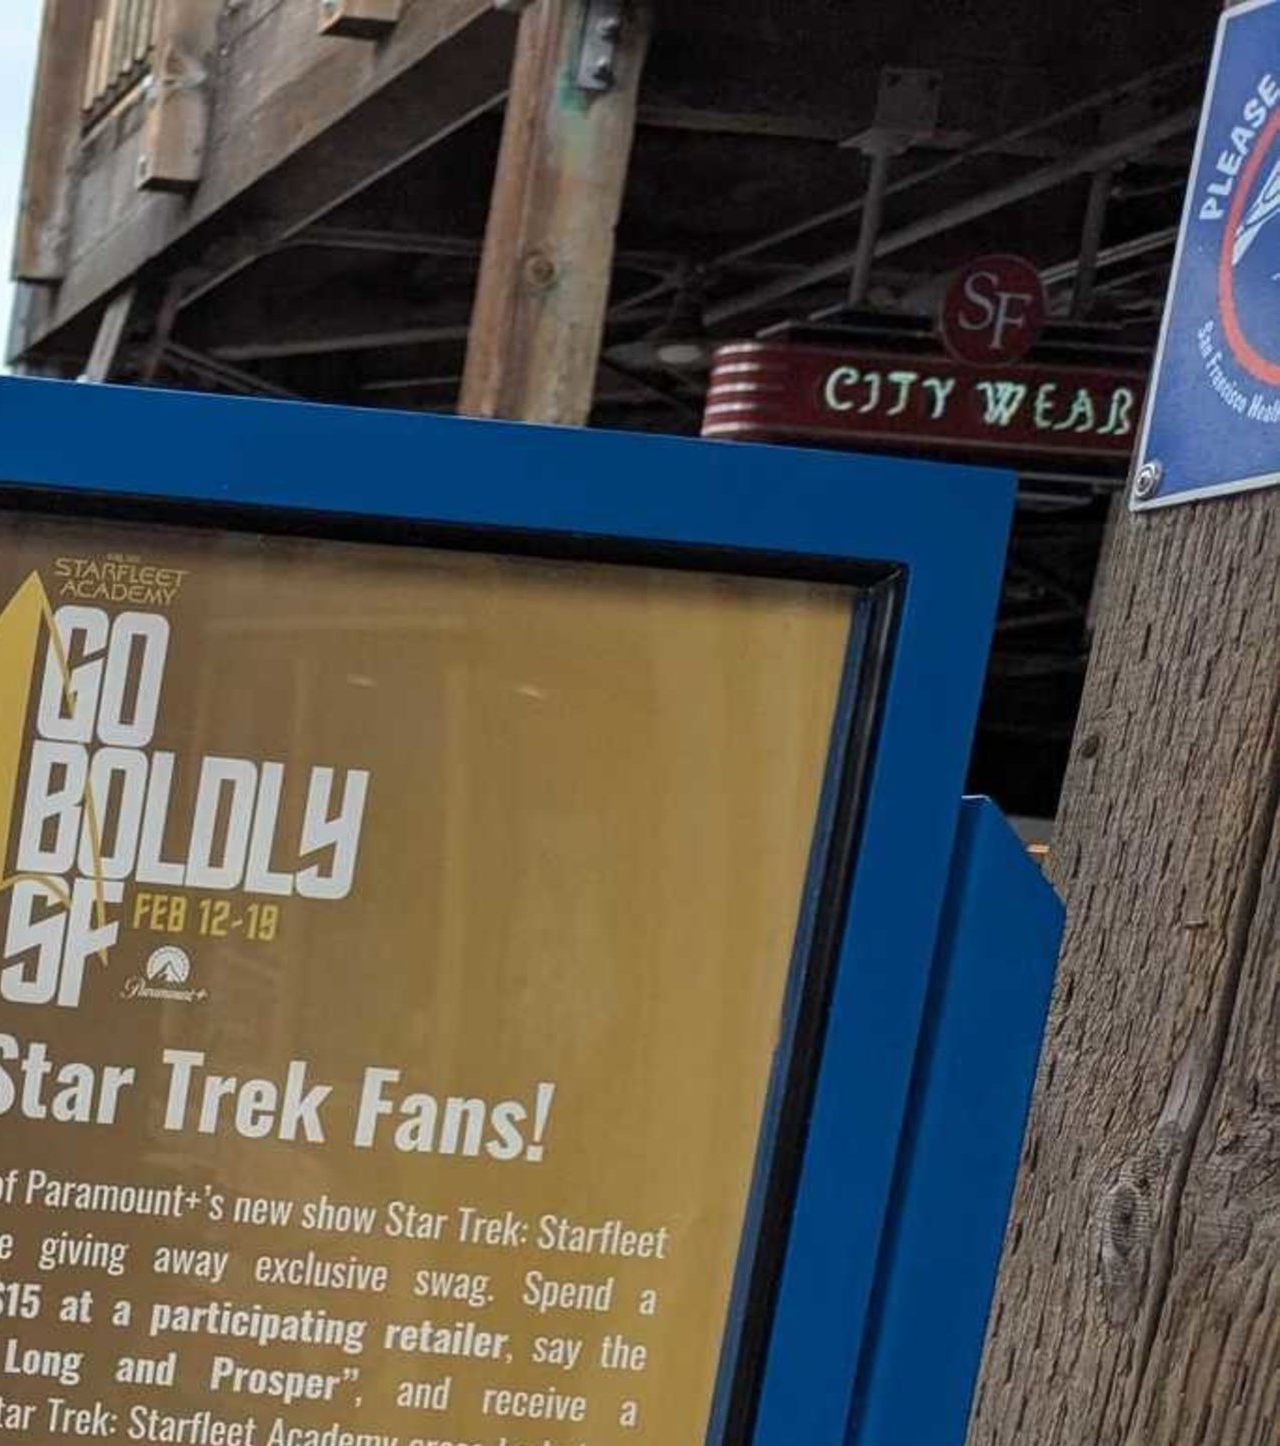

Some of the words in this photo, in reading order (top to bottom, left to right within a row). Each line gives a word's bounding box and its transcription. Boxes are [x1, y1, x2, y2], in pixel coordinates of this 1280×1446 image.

[1199, 74, 1280, 220] PLEASE
[958, 271, 1031, 349] SF
[825, 367, 955, 418] CITY
[976, 380, 1133, 435] WEAR
[1205, 351, 1247, 412] Francisco
[54, 557, 190, 587] STARFLEET
[60, 580, 177, 605] ACADEMY
[35, 604, 170, 749] GO
[15, 739, 370, 900] BOLDLY
[0, 875, 125, 1008] SF
[133, 893, 187, 932] FEB
[199, 899, 279, 941] 12-19
[162, 1048, 333, 1144] Trek
[353, 1065, 556, 1163] Fans!
[234, 1196, 292, 1226] new
[302, 1195, 376, 1234] show
[386, 1201, 448, 1240] Star
[459, 1206, 528, 1247] Trek:
[537, 1214, 669, 1259] Starfleet
[38, 1231, 129, 1276] giving
[153, 1246, 228, 1283] away
[255, 1252, 387, 1292] exclusive
[414, 1270, 494, 1307] swag.
[522, 1270, 614, 1313] Spend
[639, 1288, 656, 1315] a
[60, 1290, 93, 1323] at
[112, 1300, 131, 1327] a
[150, 1302, 367, 1354] participating
[384, 1320, 513, 1364] retailer,
[533, 1335, 582, 1370] say
[601, 1334, 647, 1371] the
[4, 1339, 83, 1385] Long
[115, 1352, 177, 1386] and
[397, 1376, 452, 1410] and
[482, 1387, 587, 1422] receive
[619, 1399, 636, 1427] a
[48, 1398, 118, 1436] Trek:
